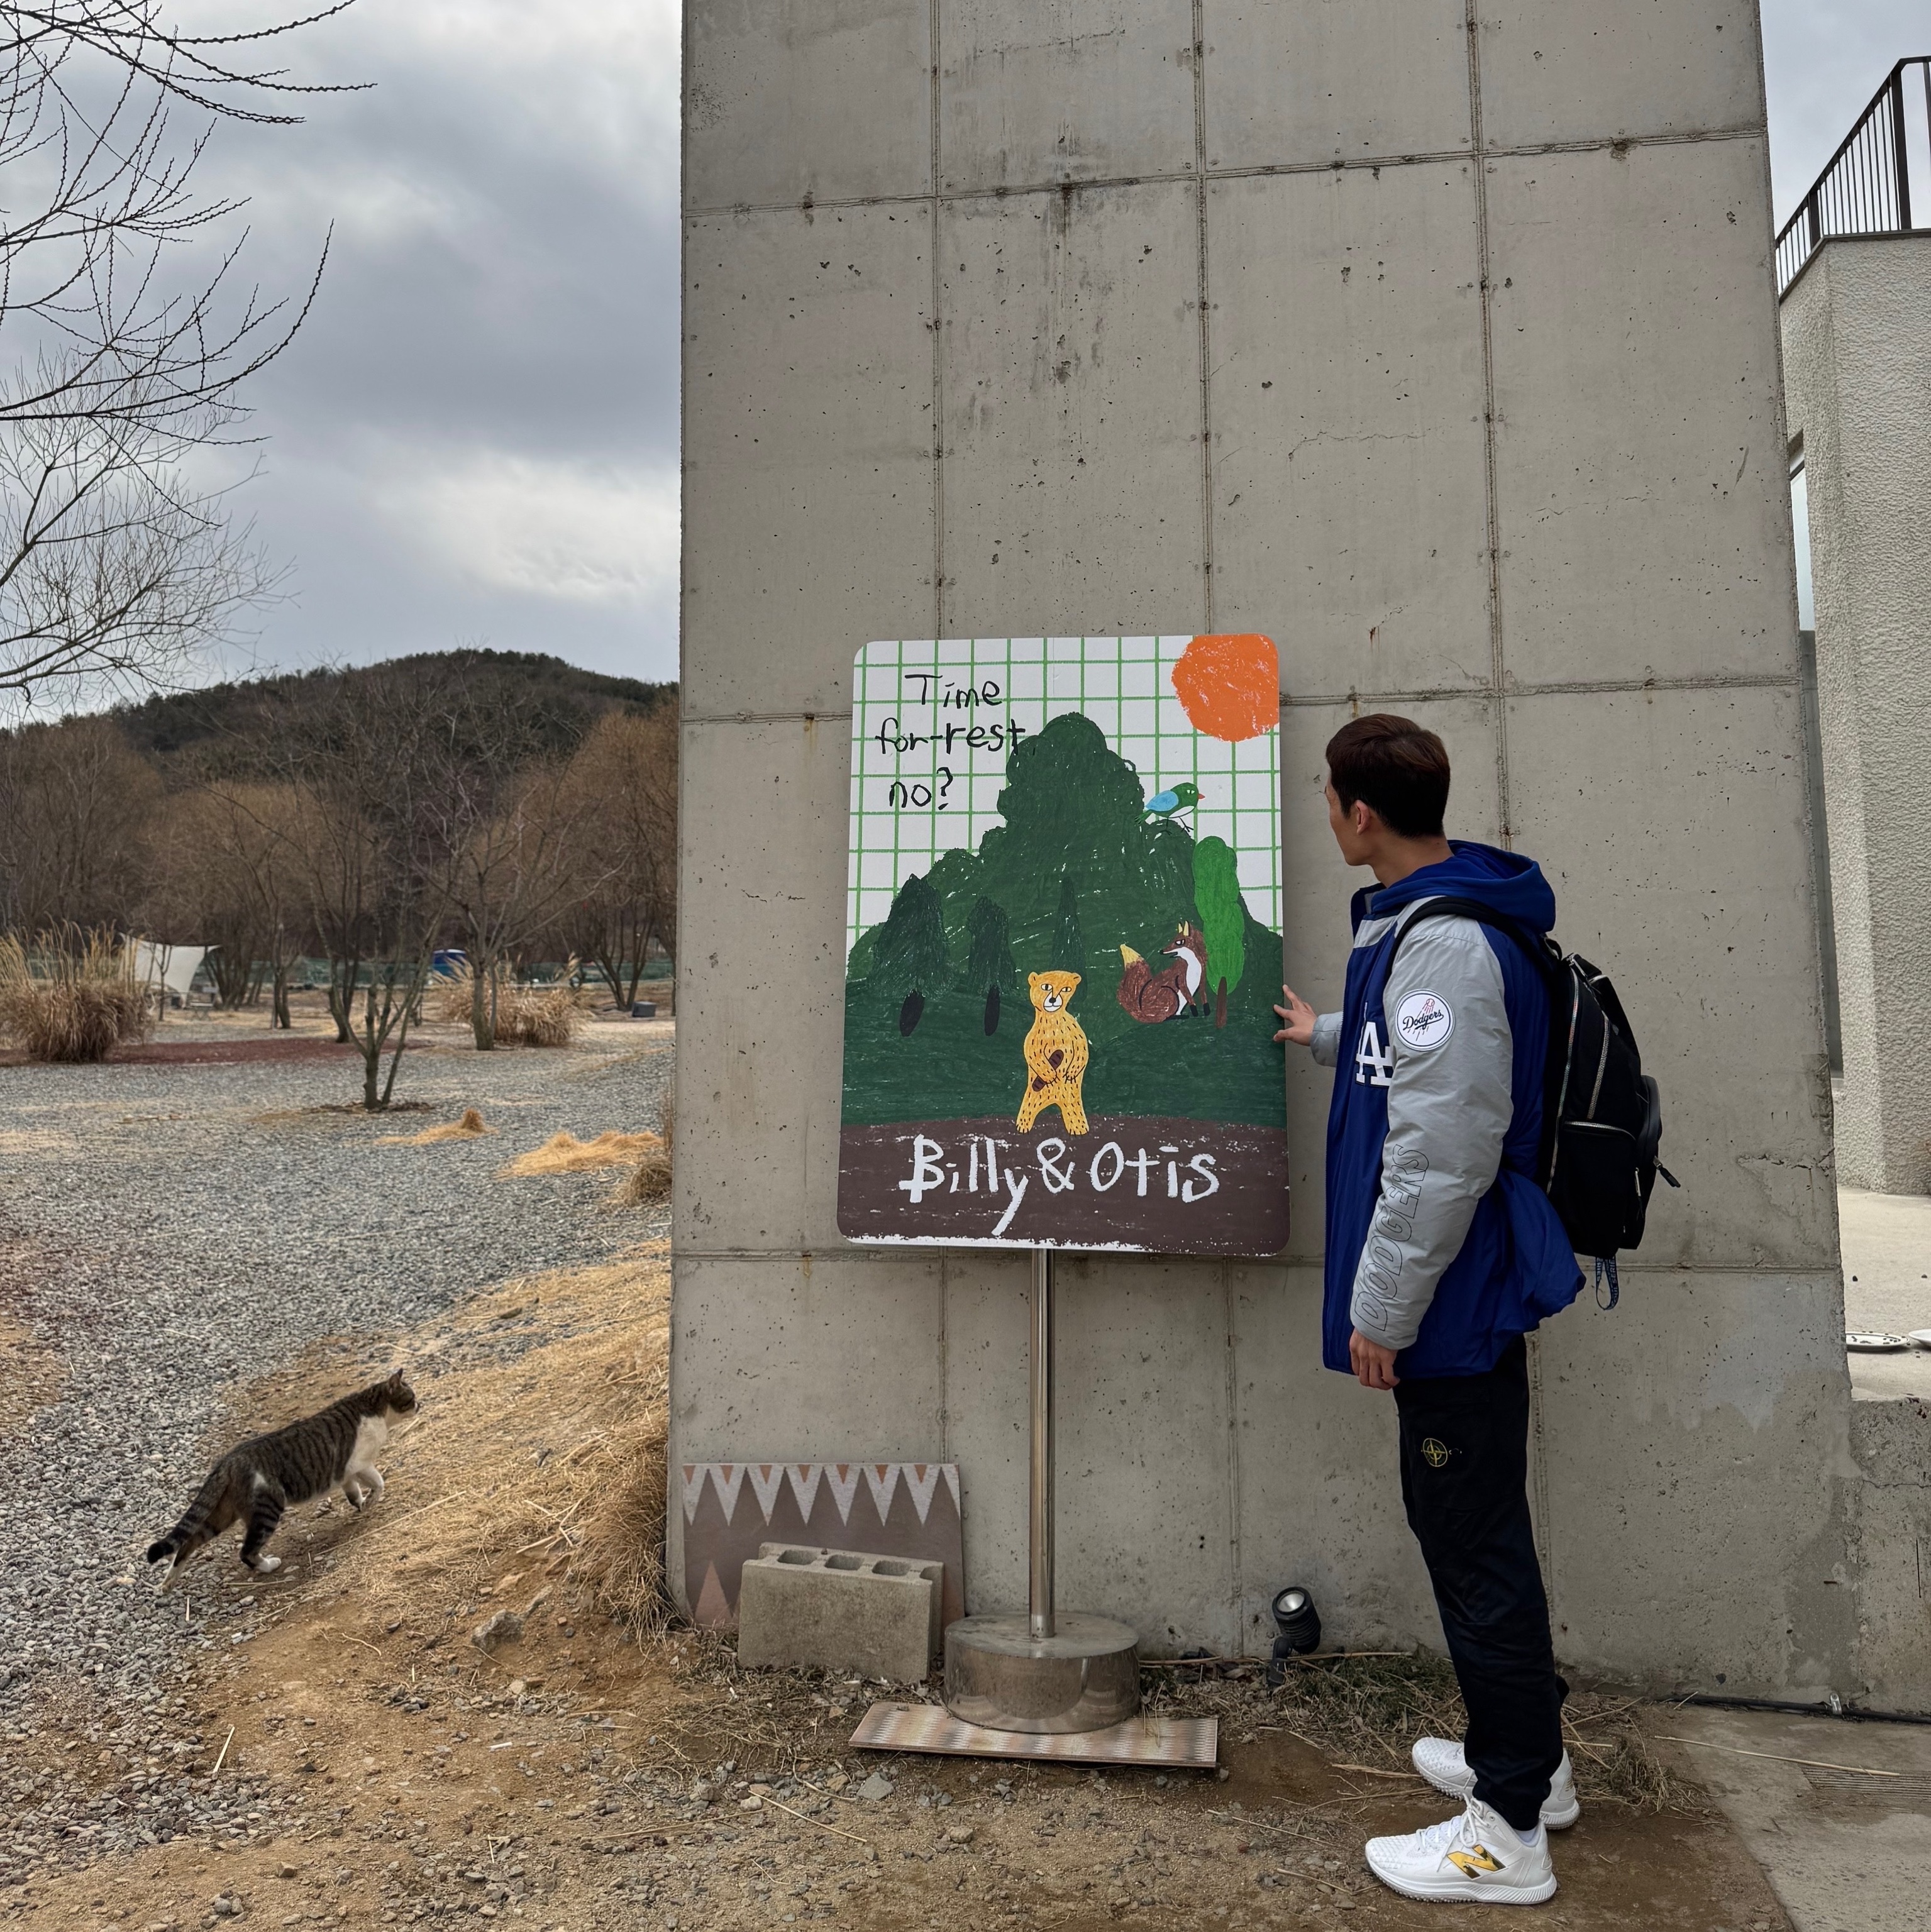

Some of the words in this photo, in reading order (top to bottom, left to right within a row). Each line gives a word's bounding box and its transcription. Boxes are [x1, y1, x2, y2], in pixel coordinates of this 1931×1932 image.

[904, 674, 1002, 709] Time
[888, 766, 953, 810] no?
[1402, 1008, 1444, 1031] Dodgers
[899, 1134, 1029, 1236] Billy
[1036, 1137, 1075, 1194] &
[1091, 1141, 1220, 1203] Otis
[1354, 1144, 1429, 1332] DODGERS
